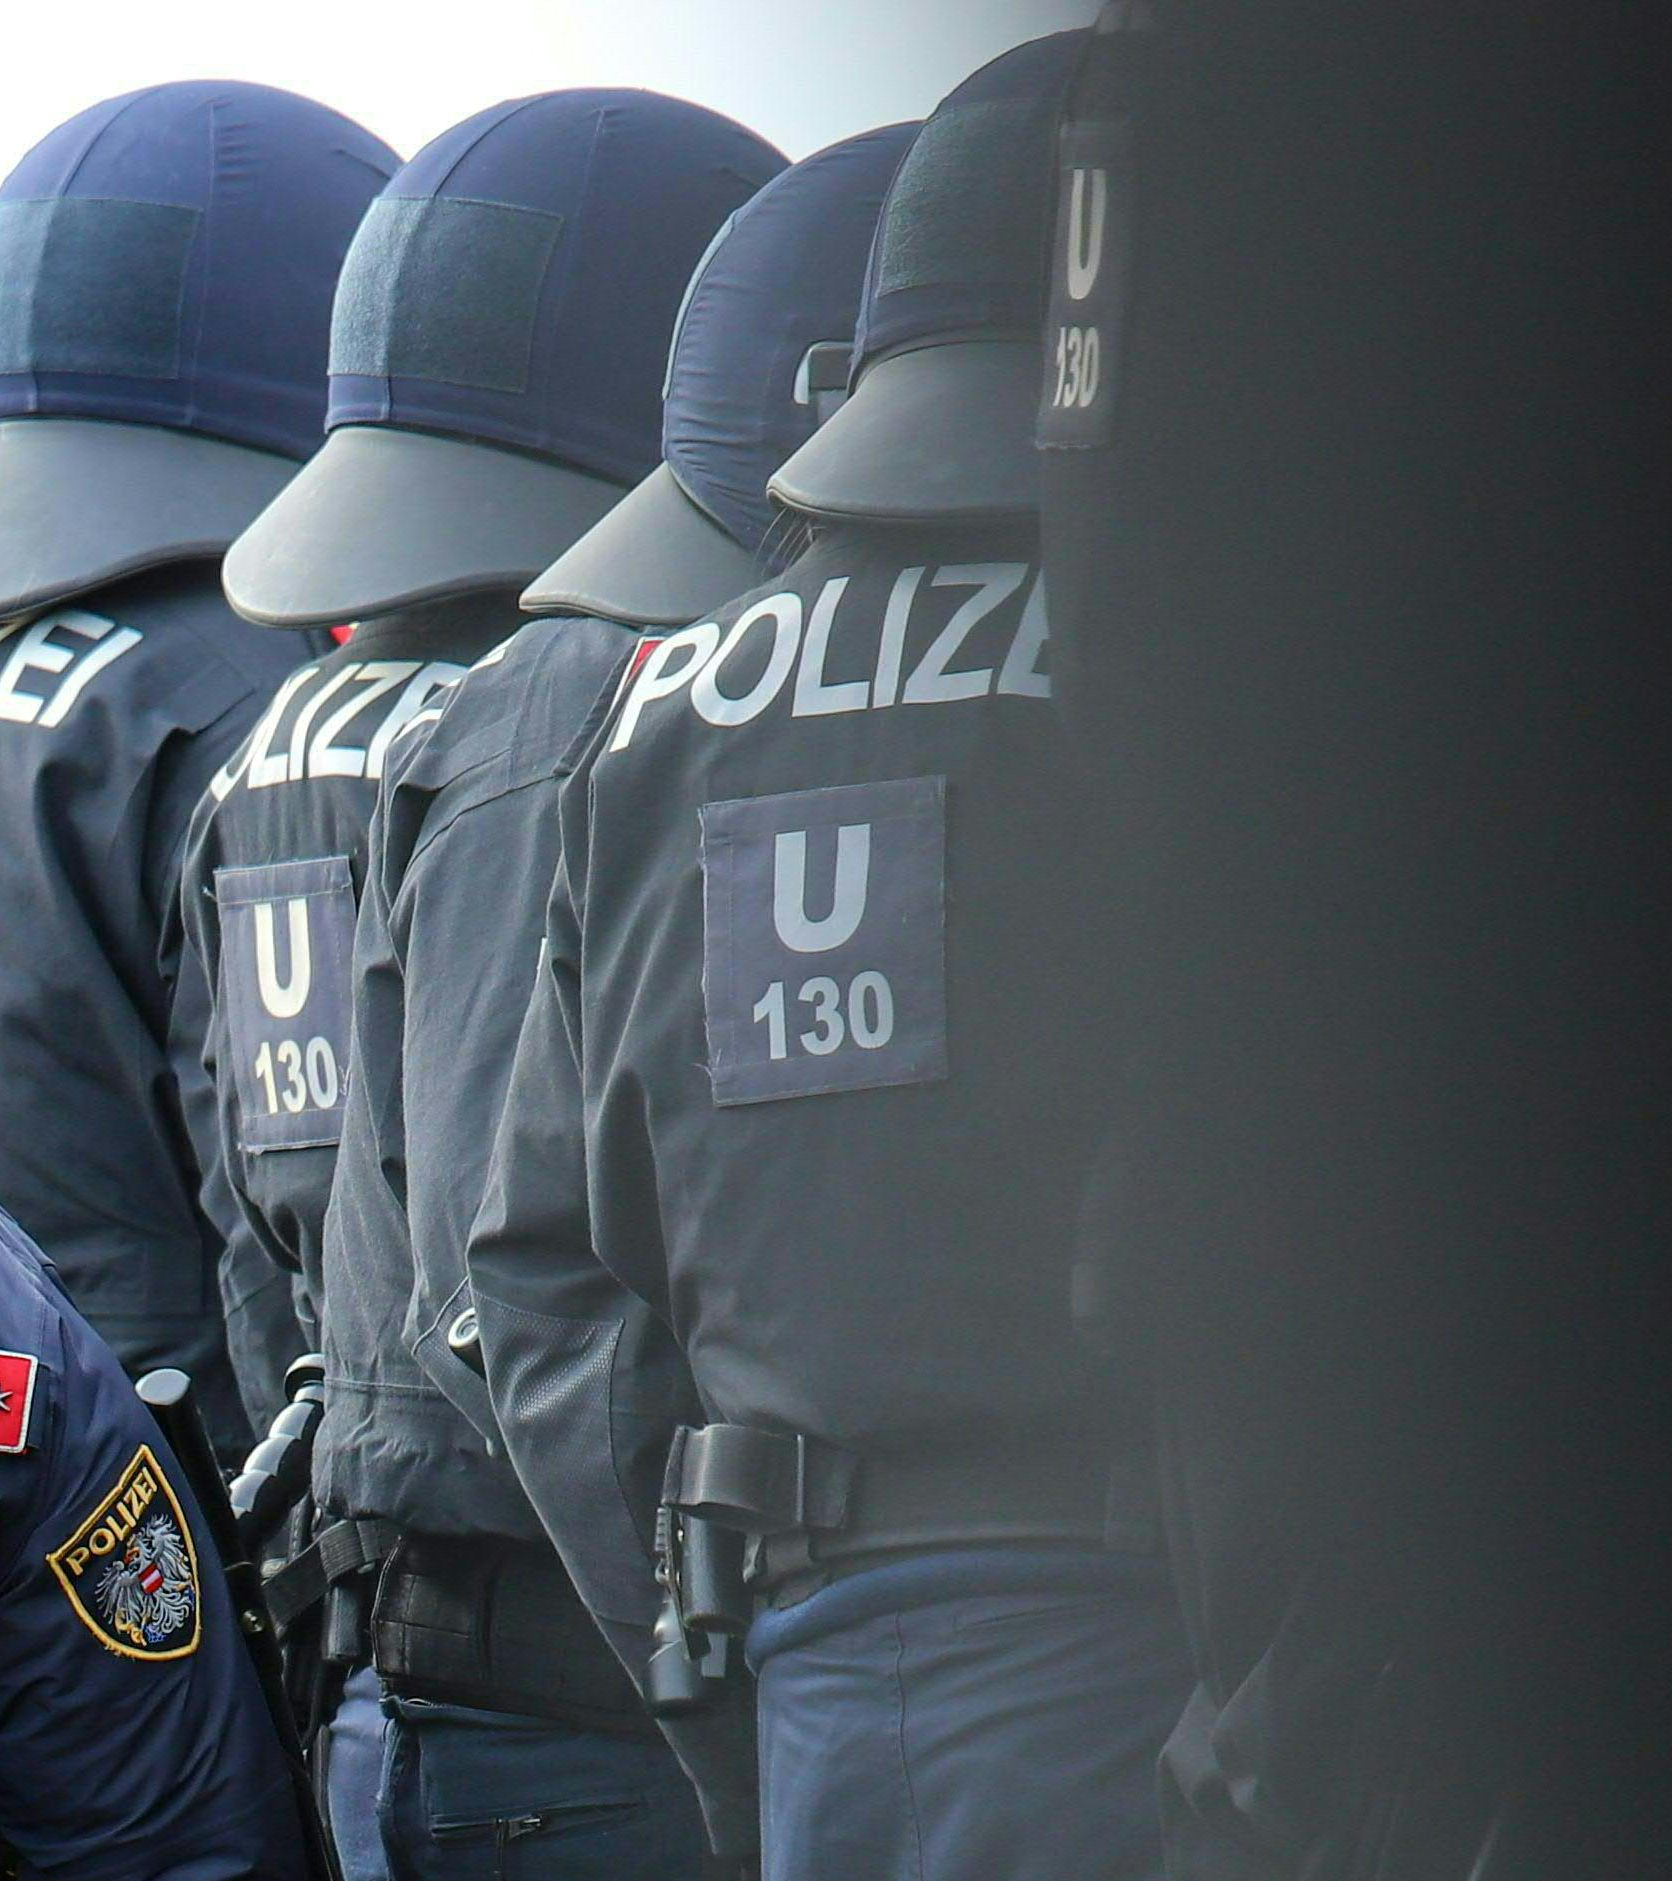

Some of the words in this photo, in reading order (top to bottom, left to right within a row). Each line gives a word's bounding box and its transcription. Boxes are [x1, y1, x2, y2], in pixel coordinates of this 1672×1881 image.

[1067, 168, 1107, 300] U
[1052, 326, 1101, 408] 130
[773, 823, 870, 954] U
[255, 896, 312, 1018] U
[753, 970, 894, 1061] 130
[256, 1035, 339, 1115] 130
[66, 1466, 158, 1576] POLIZEI
